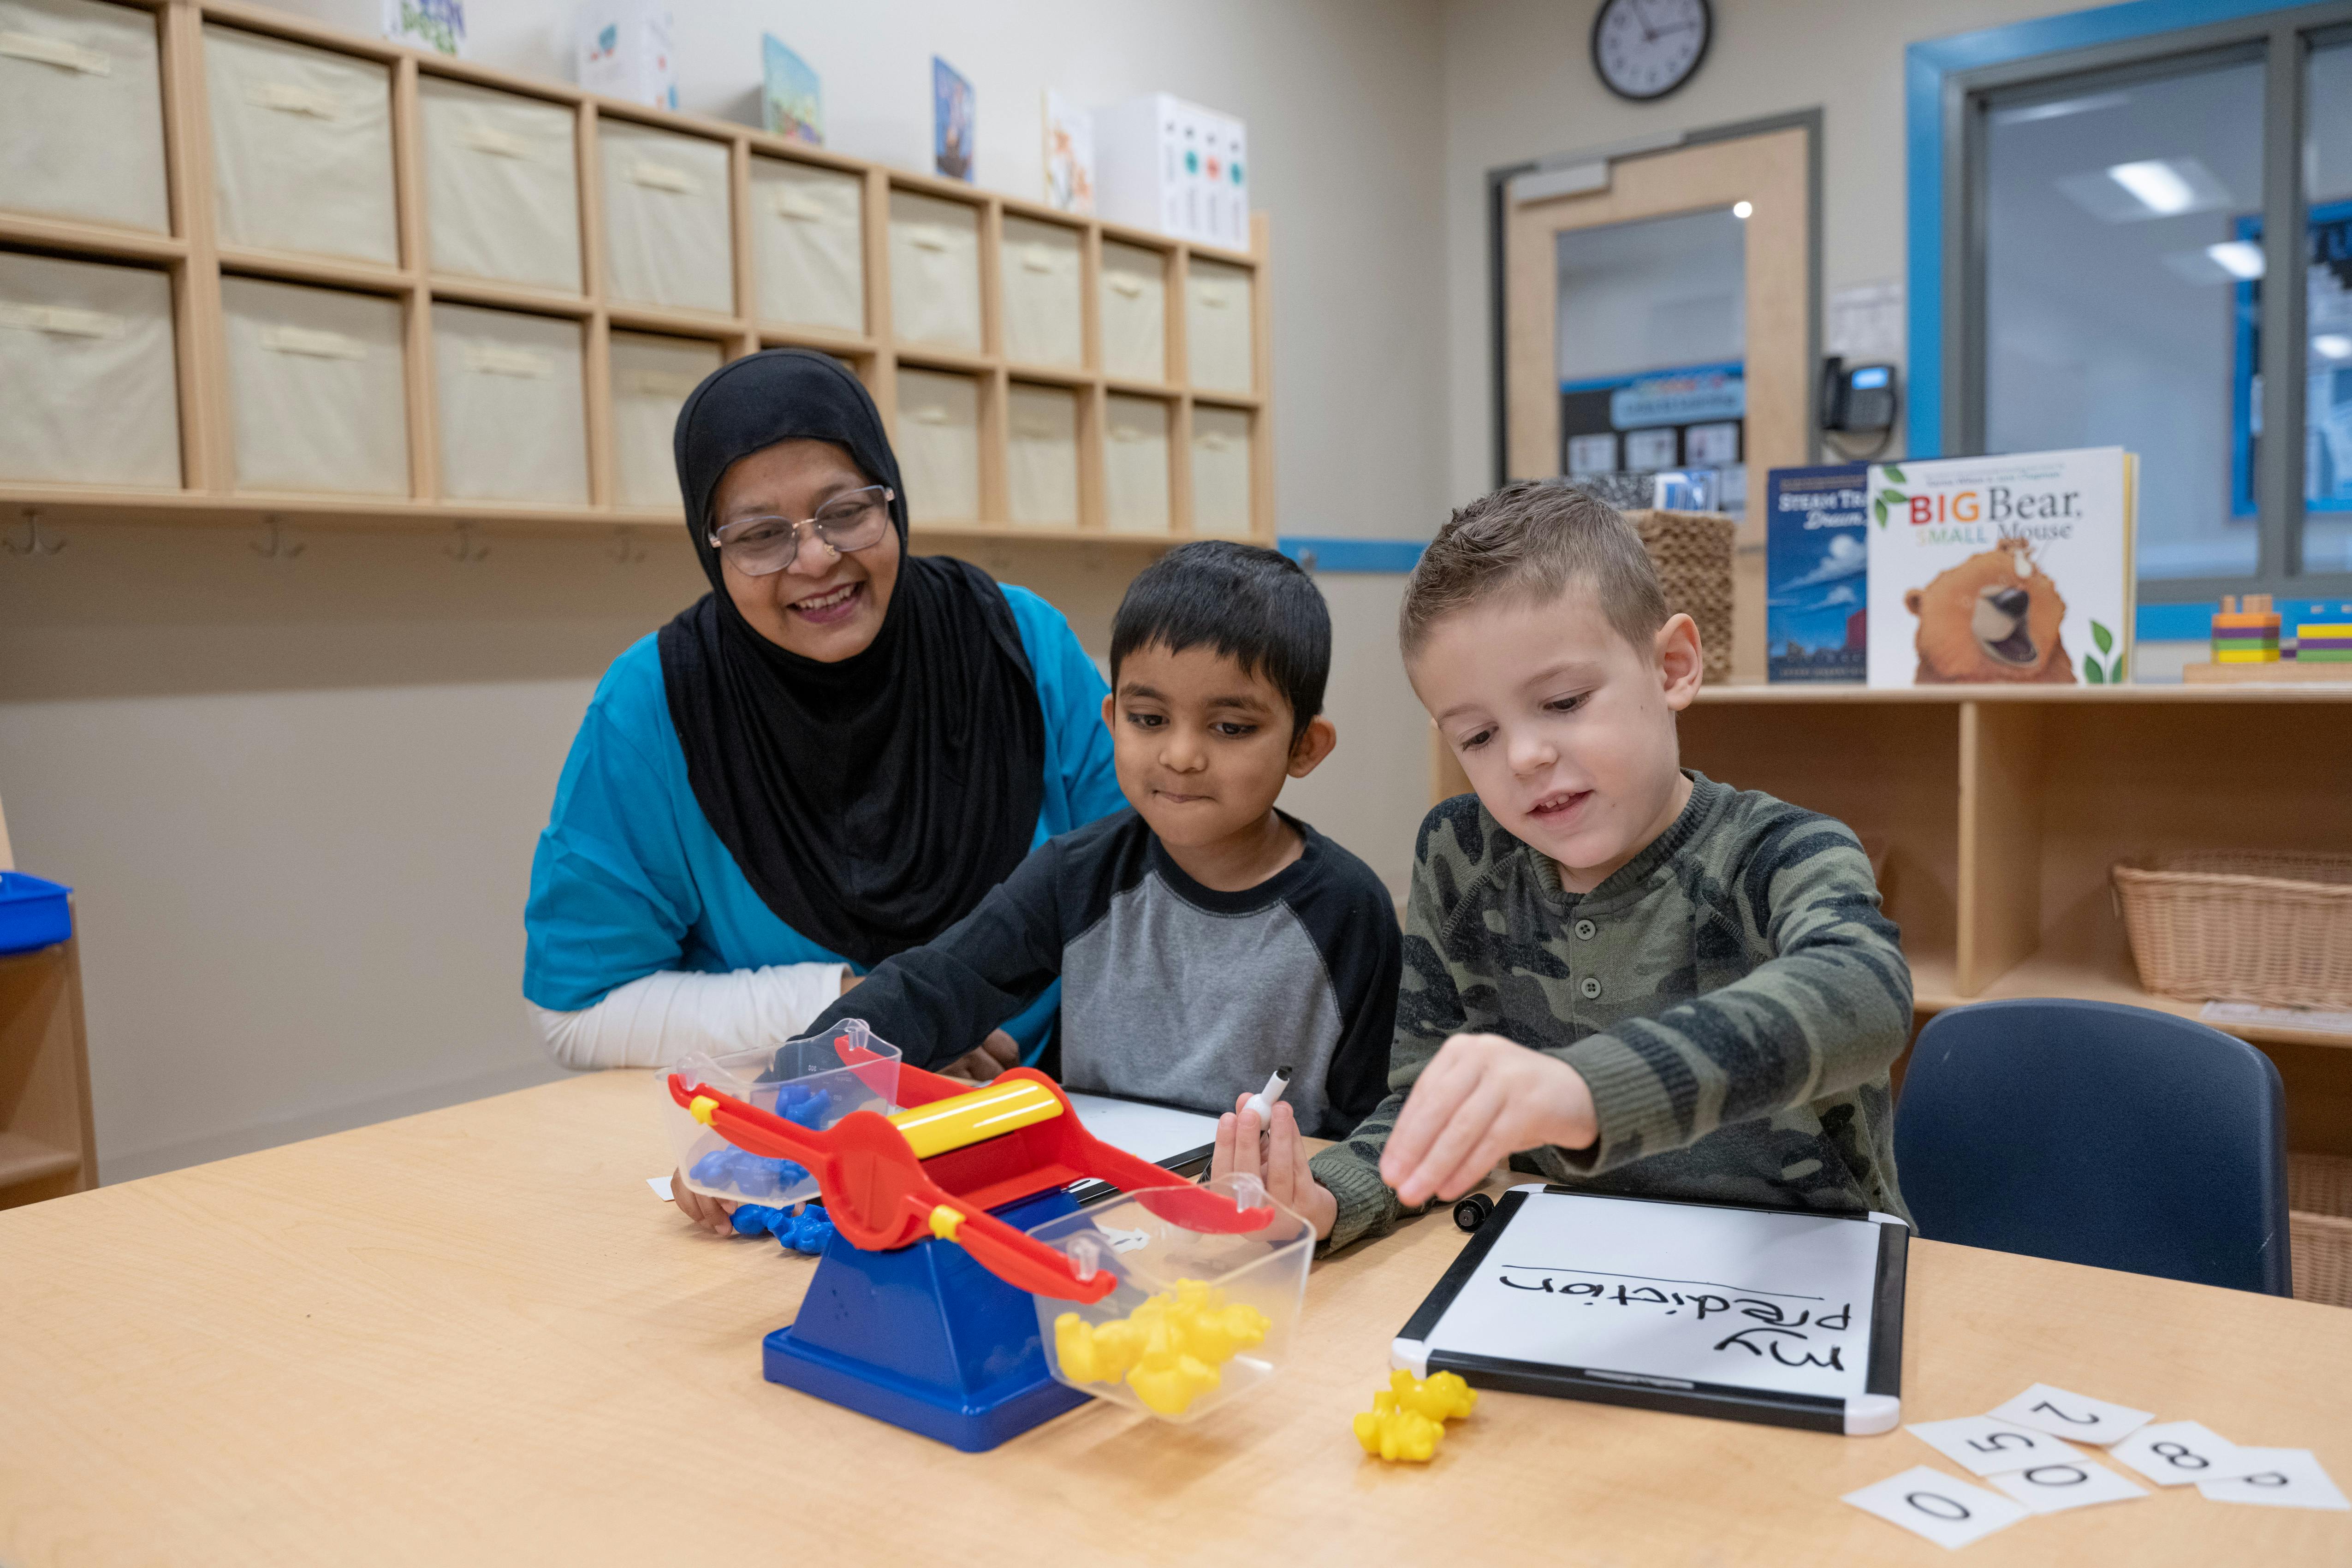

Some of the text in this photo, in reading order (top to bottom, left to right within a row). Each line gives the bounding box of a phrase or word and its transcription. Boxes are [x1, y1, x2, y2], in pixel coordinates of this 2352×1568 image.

[1778, 493, 1838, 512] STEAM
[1909, 491, 1979, 524] BIG
[1916, 522, 2073, 546] SMALL Mouse
[2030, 1400, 2099, 1424] 2
[1966, 1432, 2034, 1453] 5
[2150, 1441, 2209, 1469] 8
[2023, 1464, 2088, 1486] 0
[1905, 1491, 1971, 1520] 0
